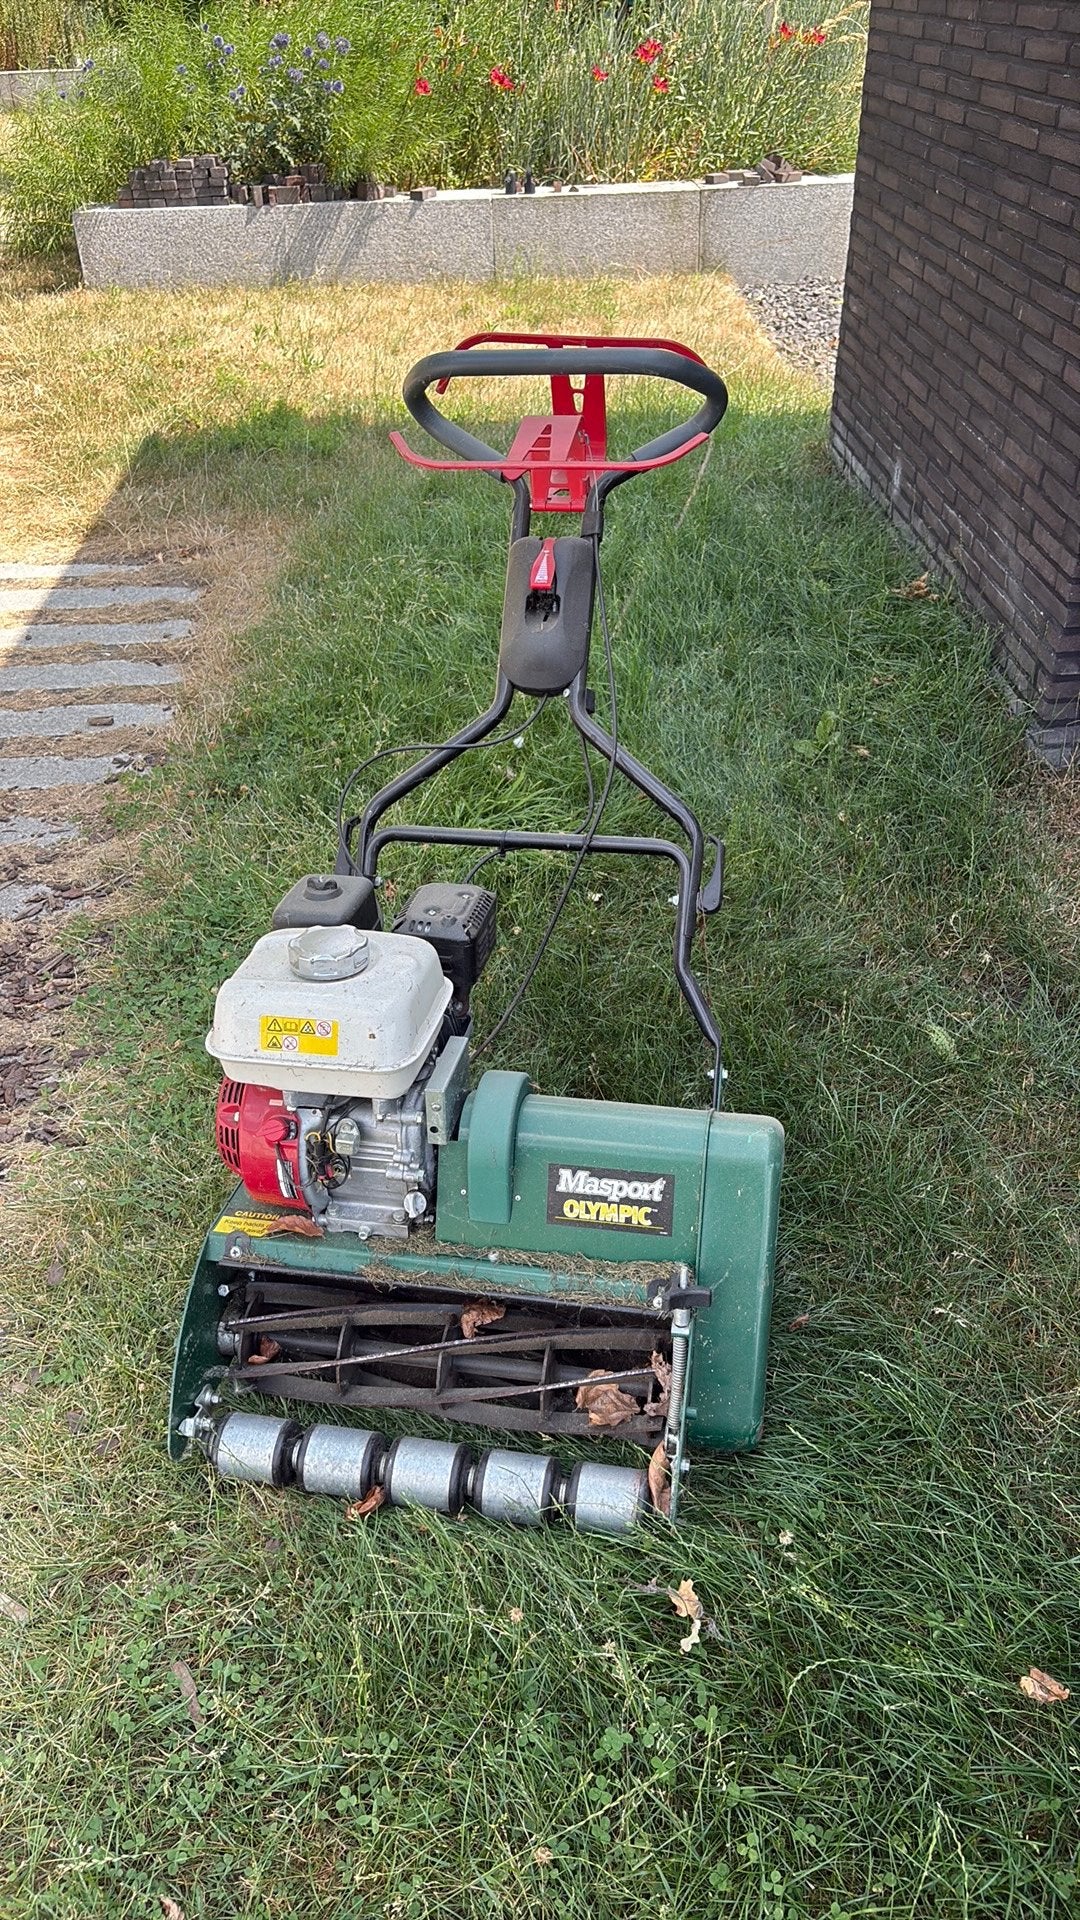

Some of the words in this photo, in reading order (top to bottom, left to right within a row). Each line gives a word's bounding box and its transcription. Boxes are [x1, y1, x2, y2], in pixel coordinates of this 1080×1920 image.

[556, 1168, 666, 1202] Masport
[234, 1210, 280, 1221] CAUTION
[563, 1199, 652, 1226] OLYMPIC
